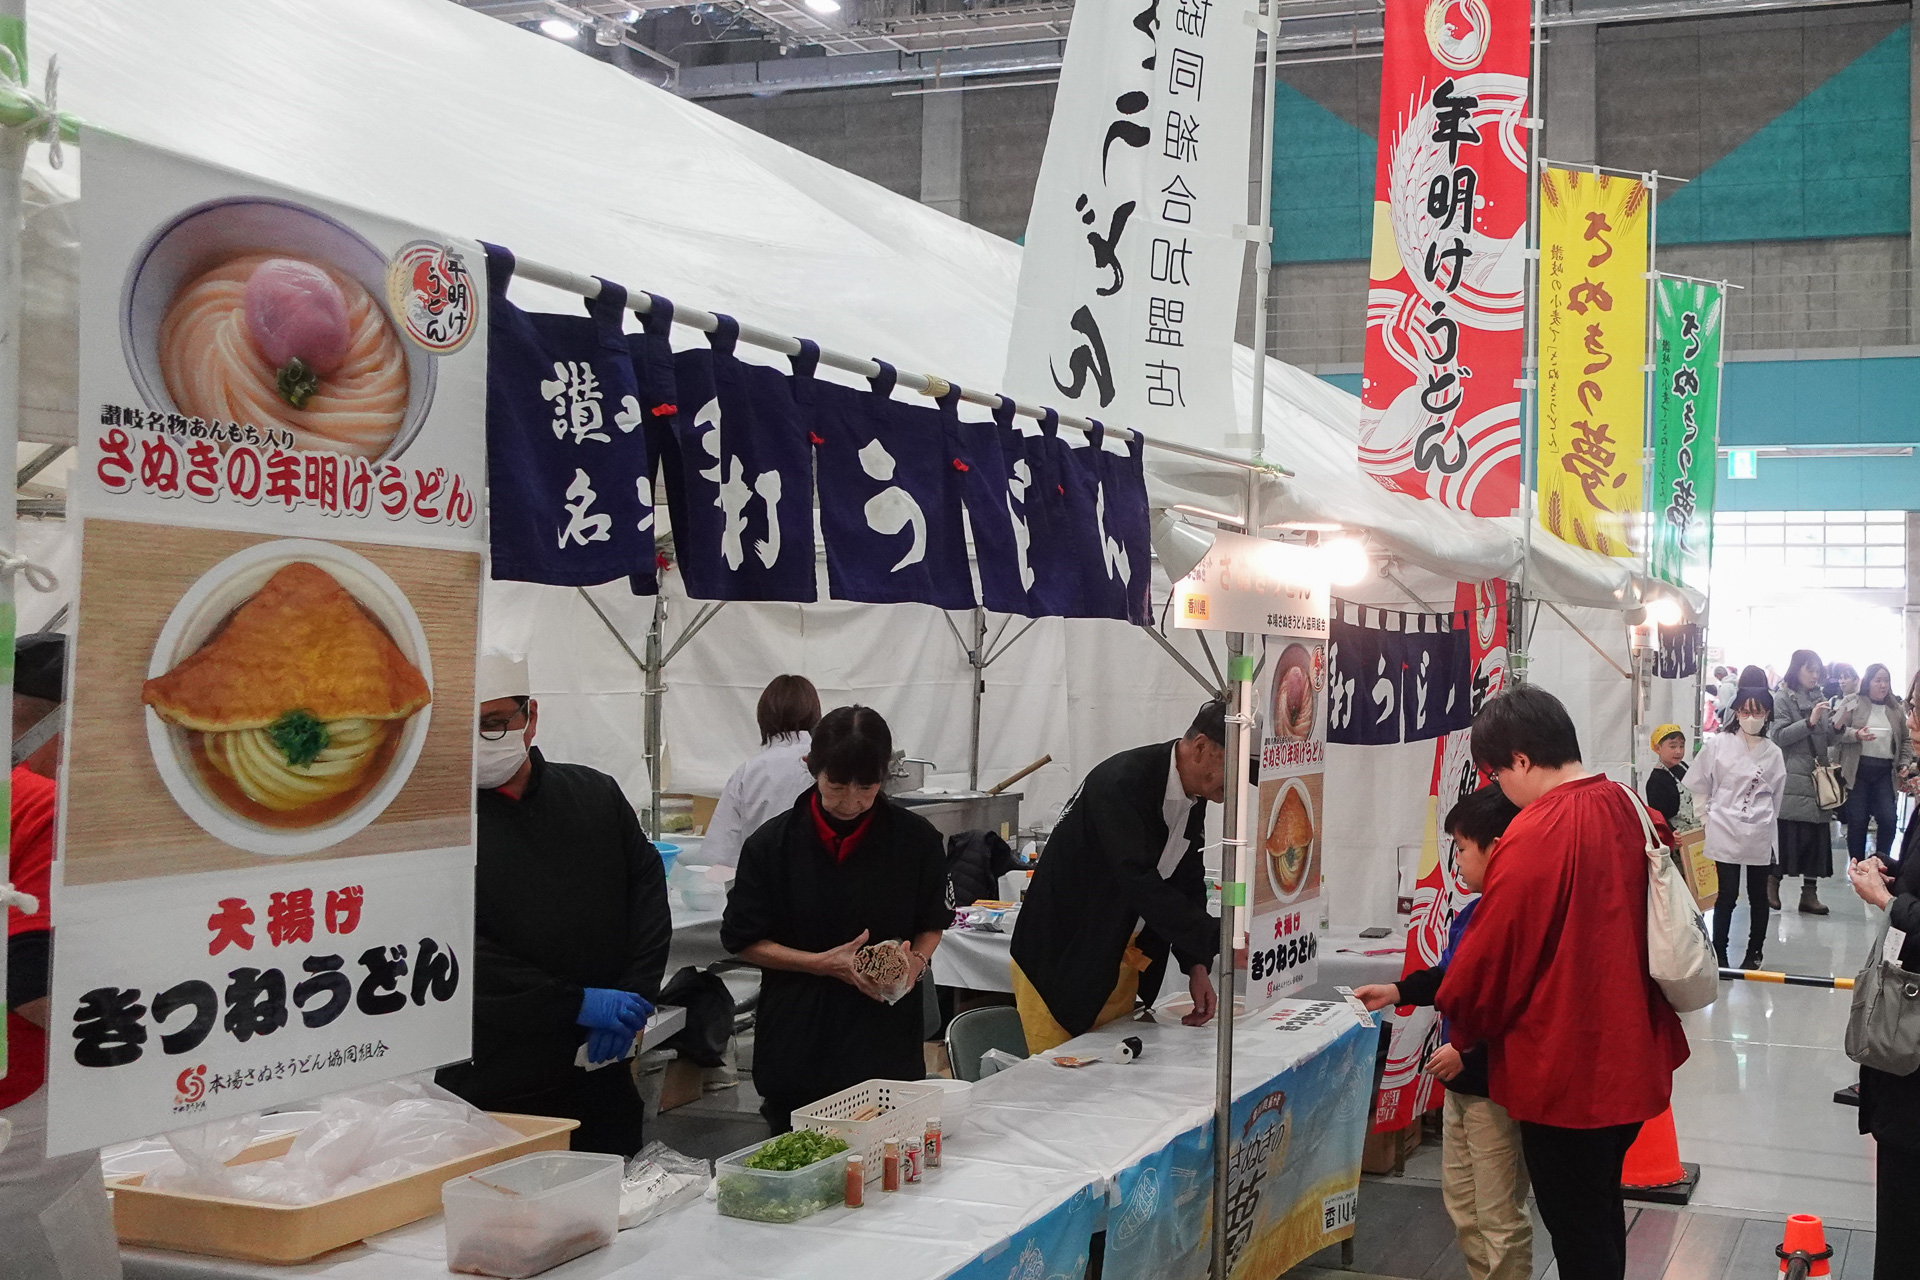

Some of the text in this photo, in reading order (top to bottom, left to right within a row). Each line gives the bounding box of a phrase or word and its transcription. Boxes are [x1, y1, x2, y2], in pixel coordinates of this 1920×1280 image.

[1414, 78, 1482, 475] 年明けうどん
[100, 404, 295, 450] 讃岐名物あんもち入り
[97, 428, 475, 523] さぬきの年明けうどん
[207, 884, 364, 956] 大揚げ
[1251, 931, 1317, 981] きつねうどん
[72, 937, 460, 1068] きつねうどん
[208, 1040, 390, 1094] 本場さぬきうどん協同組合
